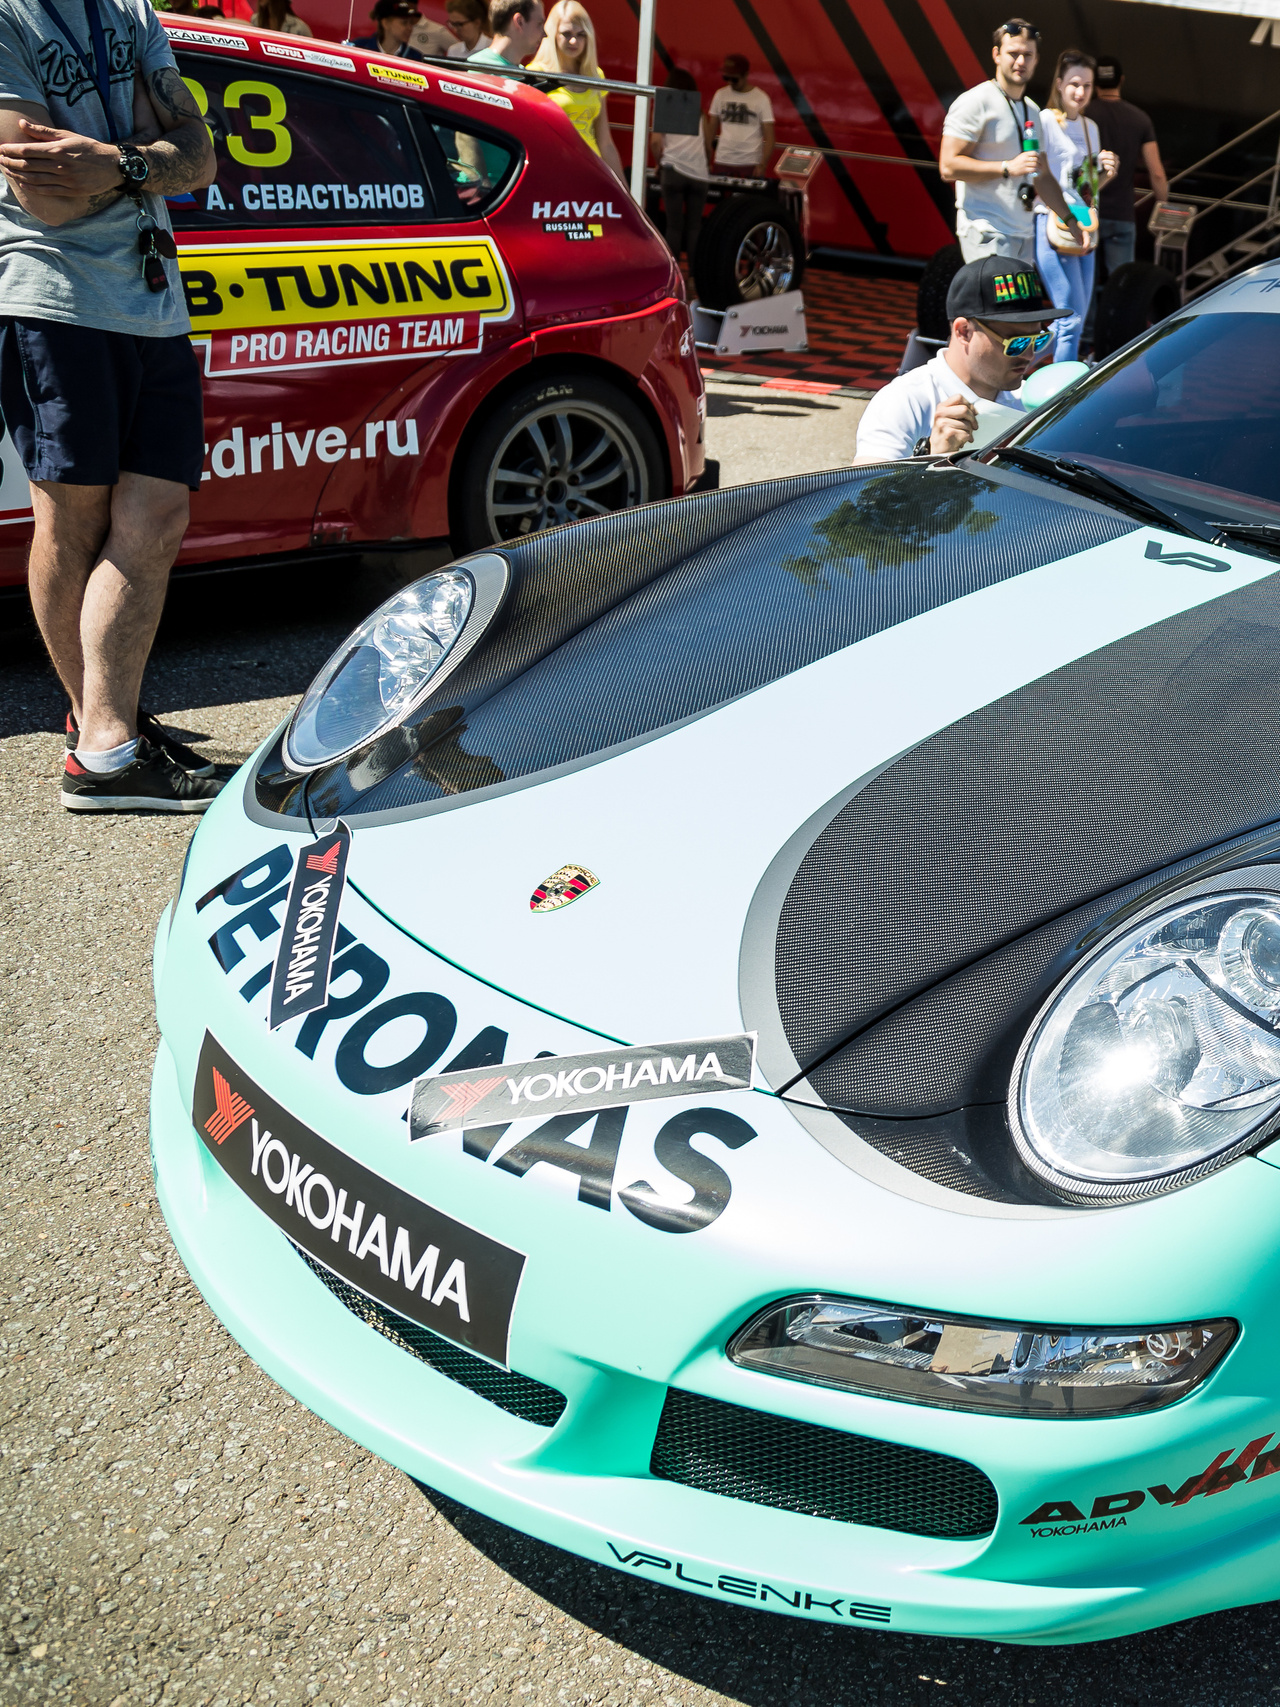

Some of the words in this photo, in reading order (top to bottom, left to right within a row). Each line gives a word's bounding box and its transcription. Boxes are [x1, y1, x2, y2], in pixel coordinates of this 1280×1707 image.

[266, 45, 303, 59] MOTUL
[181, 76, 293, 168] 3
[206, 184, 235, 211] А.
[242, 184, 425, 211] СЕВАСТЬЯНОВ
[532, 201, 622, 219] HAVAL
[545, 222, 584, 232] RUSSIAN
[567, 231, 592, 240] TEAM
[230, 332, 287, 364] PRO
[295, 323, 390, 358] RACING
[398, 317, 465, 349] TEAM
[283, 874, 334, 1006] YOKOHAMA
[506, 1052, 725, 1105] YOKOHAMA
[251, 1117, 471, 1323] YOKOHAMA
[1029, 1516, 1128, 1538] YOKOHAMA
[605, 1540, 892, 1624] VPLENKE
